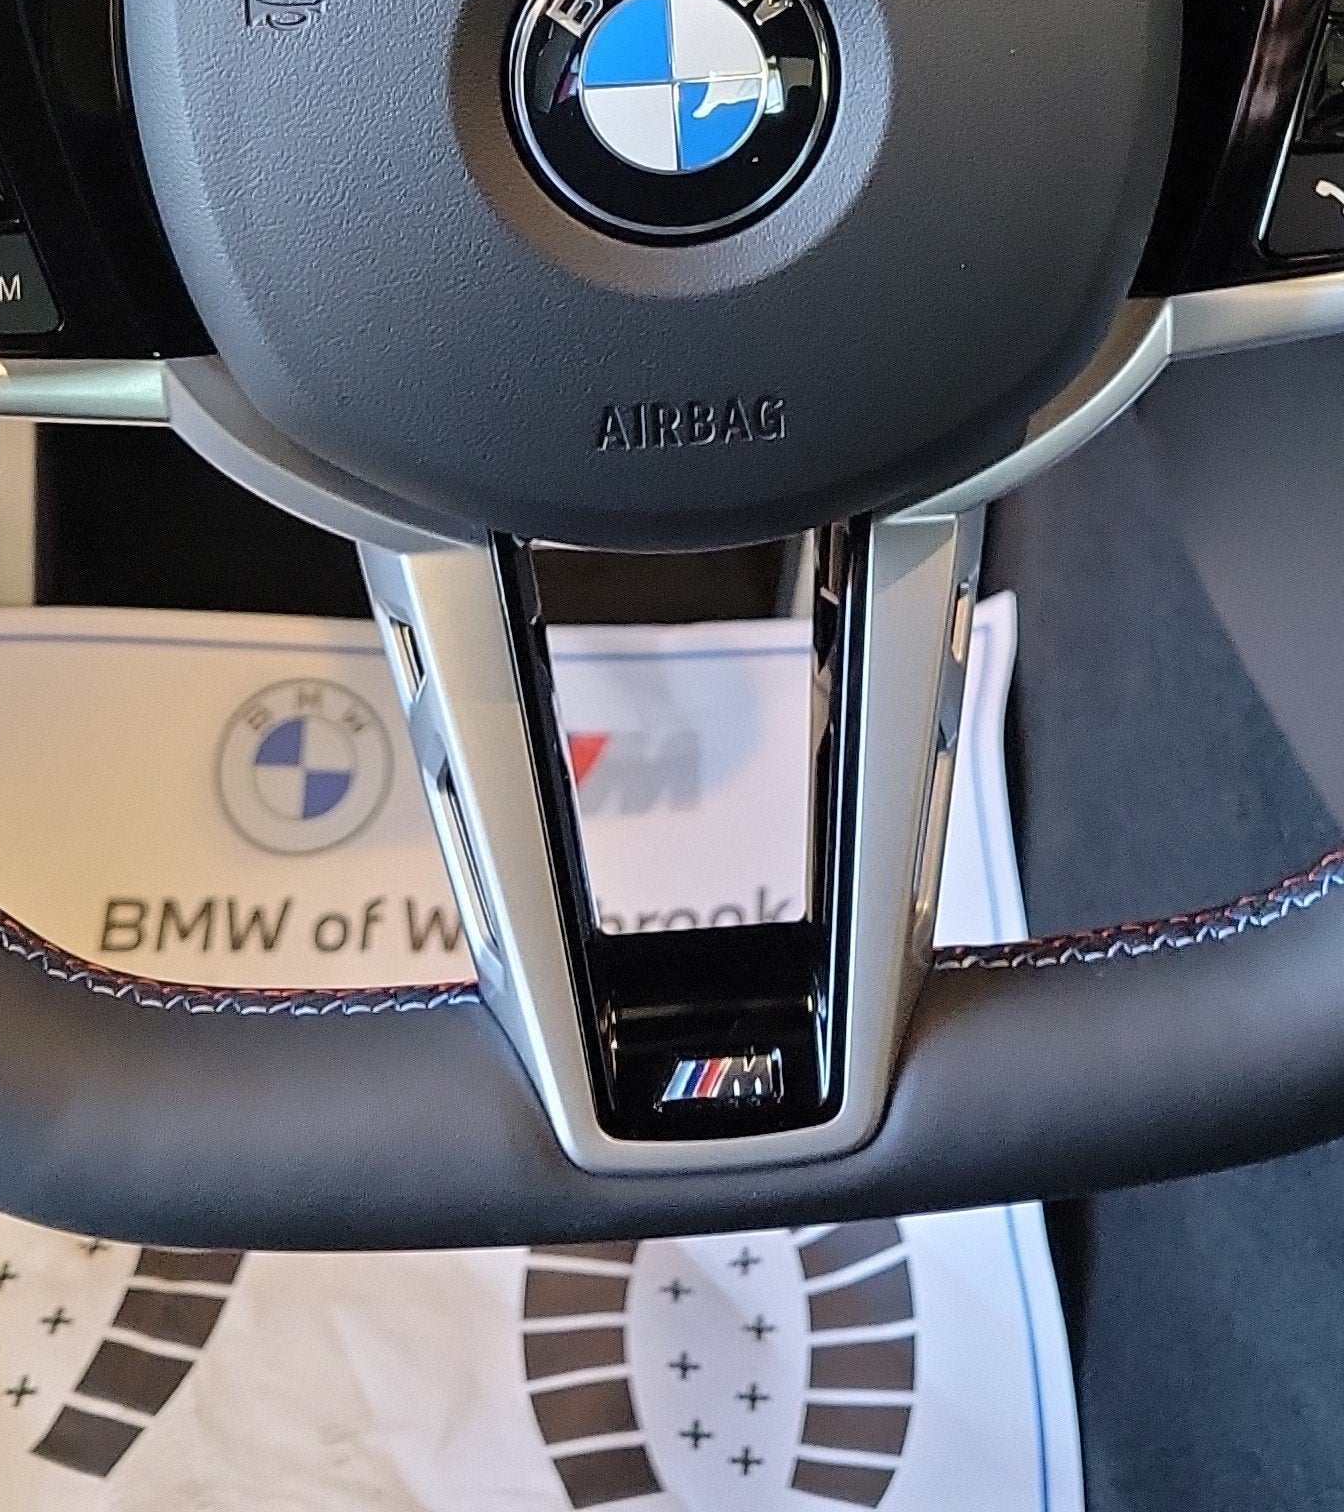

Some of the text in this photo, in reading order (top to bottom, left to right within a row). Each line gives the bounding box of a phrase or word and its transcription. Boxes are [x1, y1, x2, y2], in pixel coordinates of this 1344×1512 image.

[597, 395, 786, 452] AIRBAG
[100, 896, 294, 954] BMW
[314, 894, 388, 954] of
